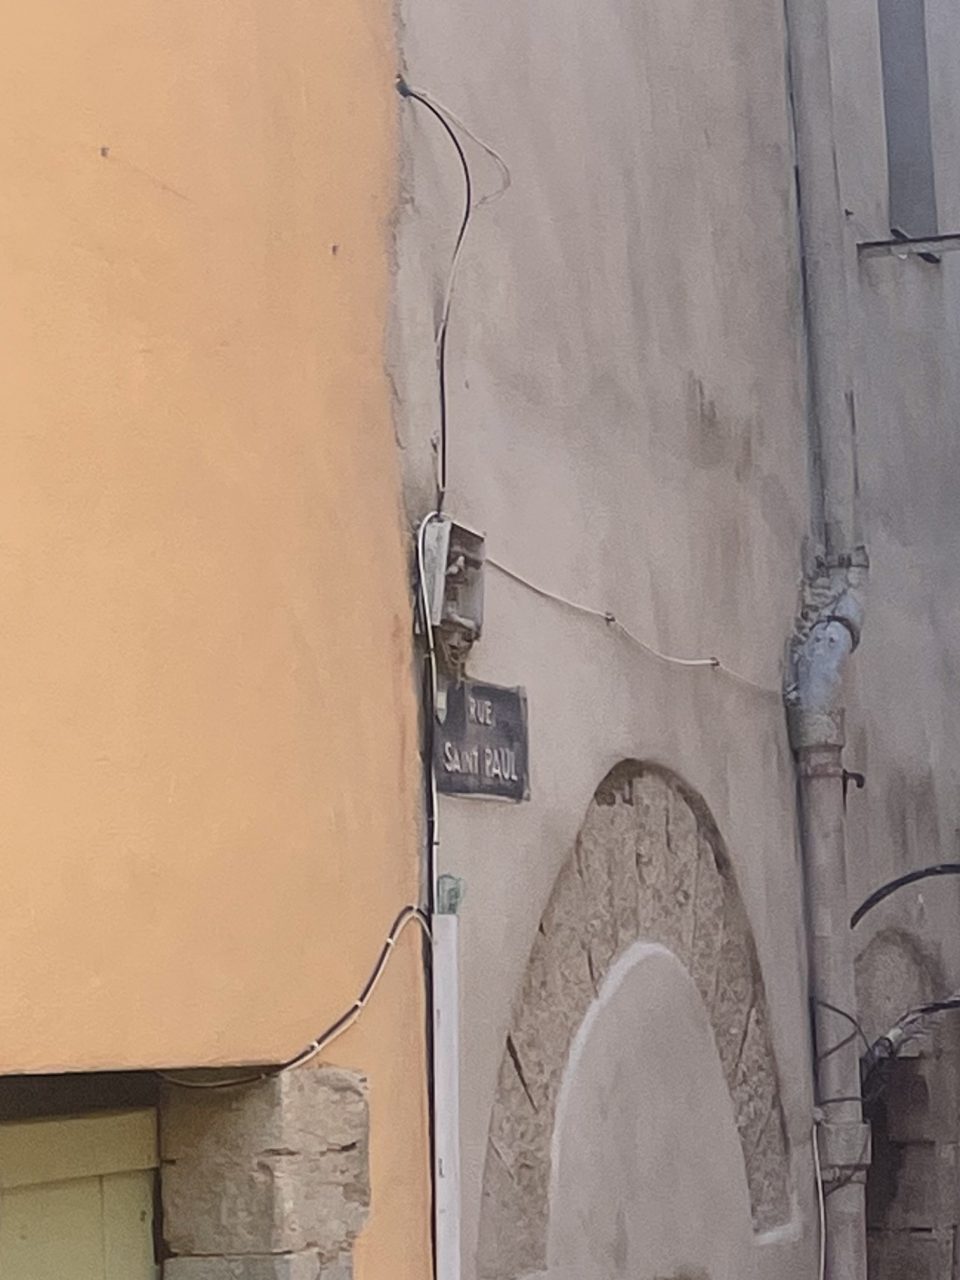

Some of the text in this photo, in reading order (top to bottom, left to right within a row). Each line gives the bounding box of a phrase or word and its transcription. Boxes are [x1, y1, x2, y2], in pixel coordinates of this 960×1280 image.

[469, 698, 493, 725] RUE
[444, 741, 518, 781] SAINT PAUL
